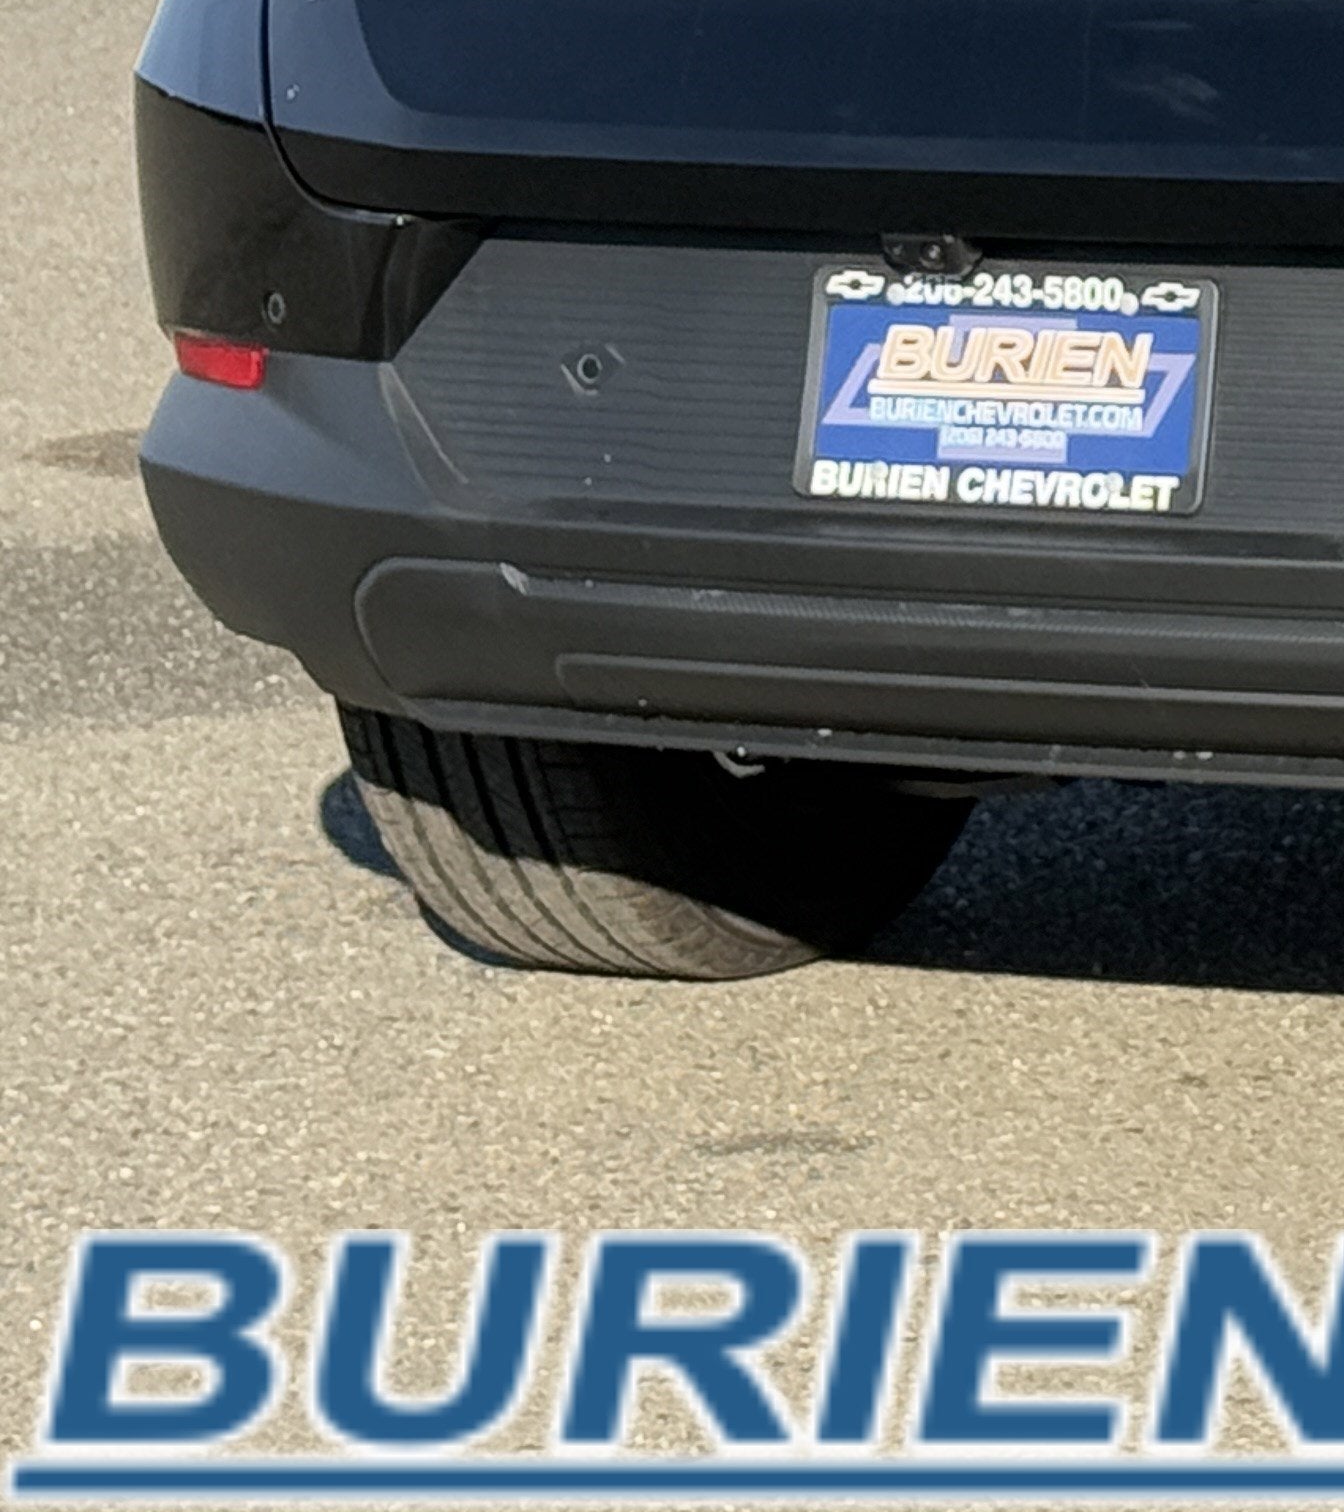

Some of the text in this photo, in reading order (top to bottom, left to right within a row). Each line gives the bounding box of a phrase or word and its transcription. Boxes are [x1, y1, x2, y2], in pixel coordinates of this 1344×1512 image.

[876, 324, 1155, 389] BURIEN
[869, 396, 1144, 432] BURIENCHEVROLET.COM
[809, 460, 1181, 512] BURIEN CHEVROLET
